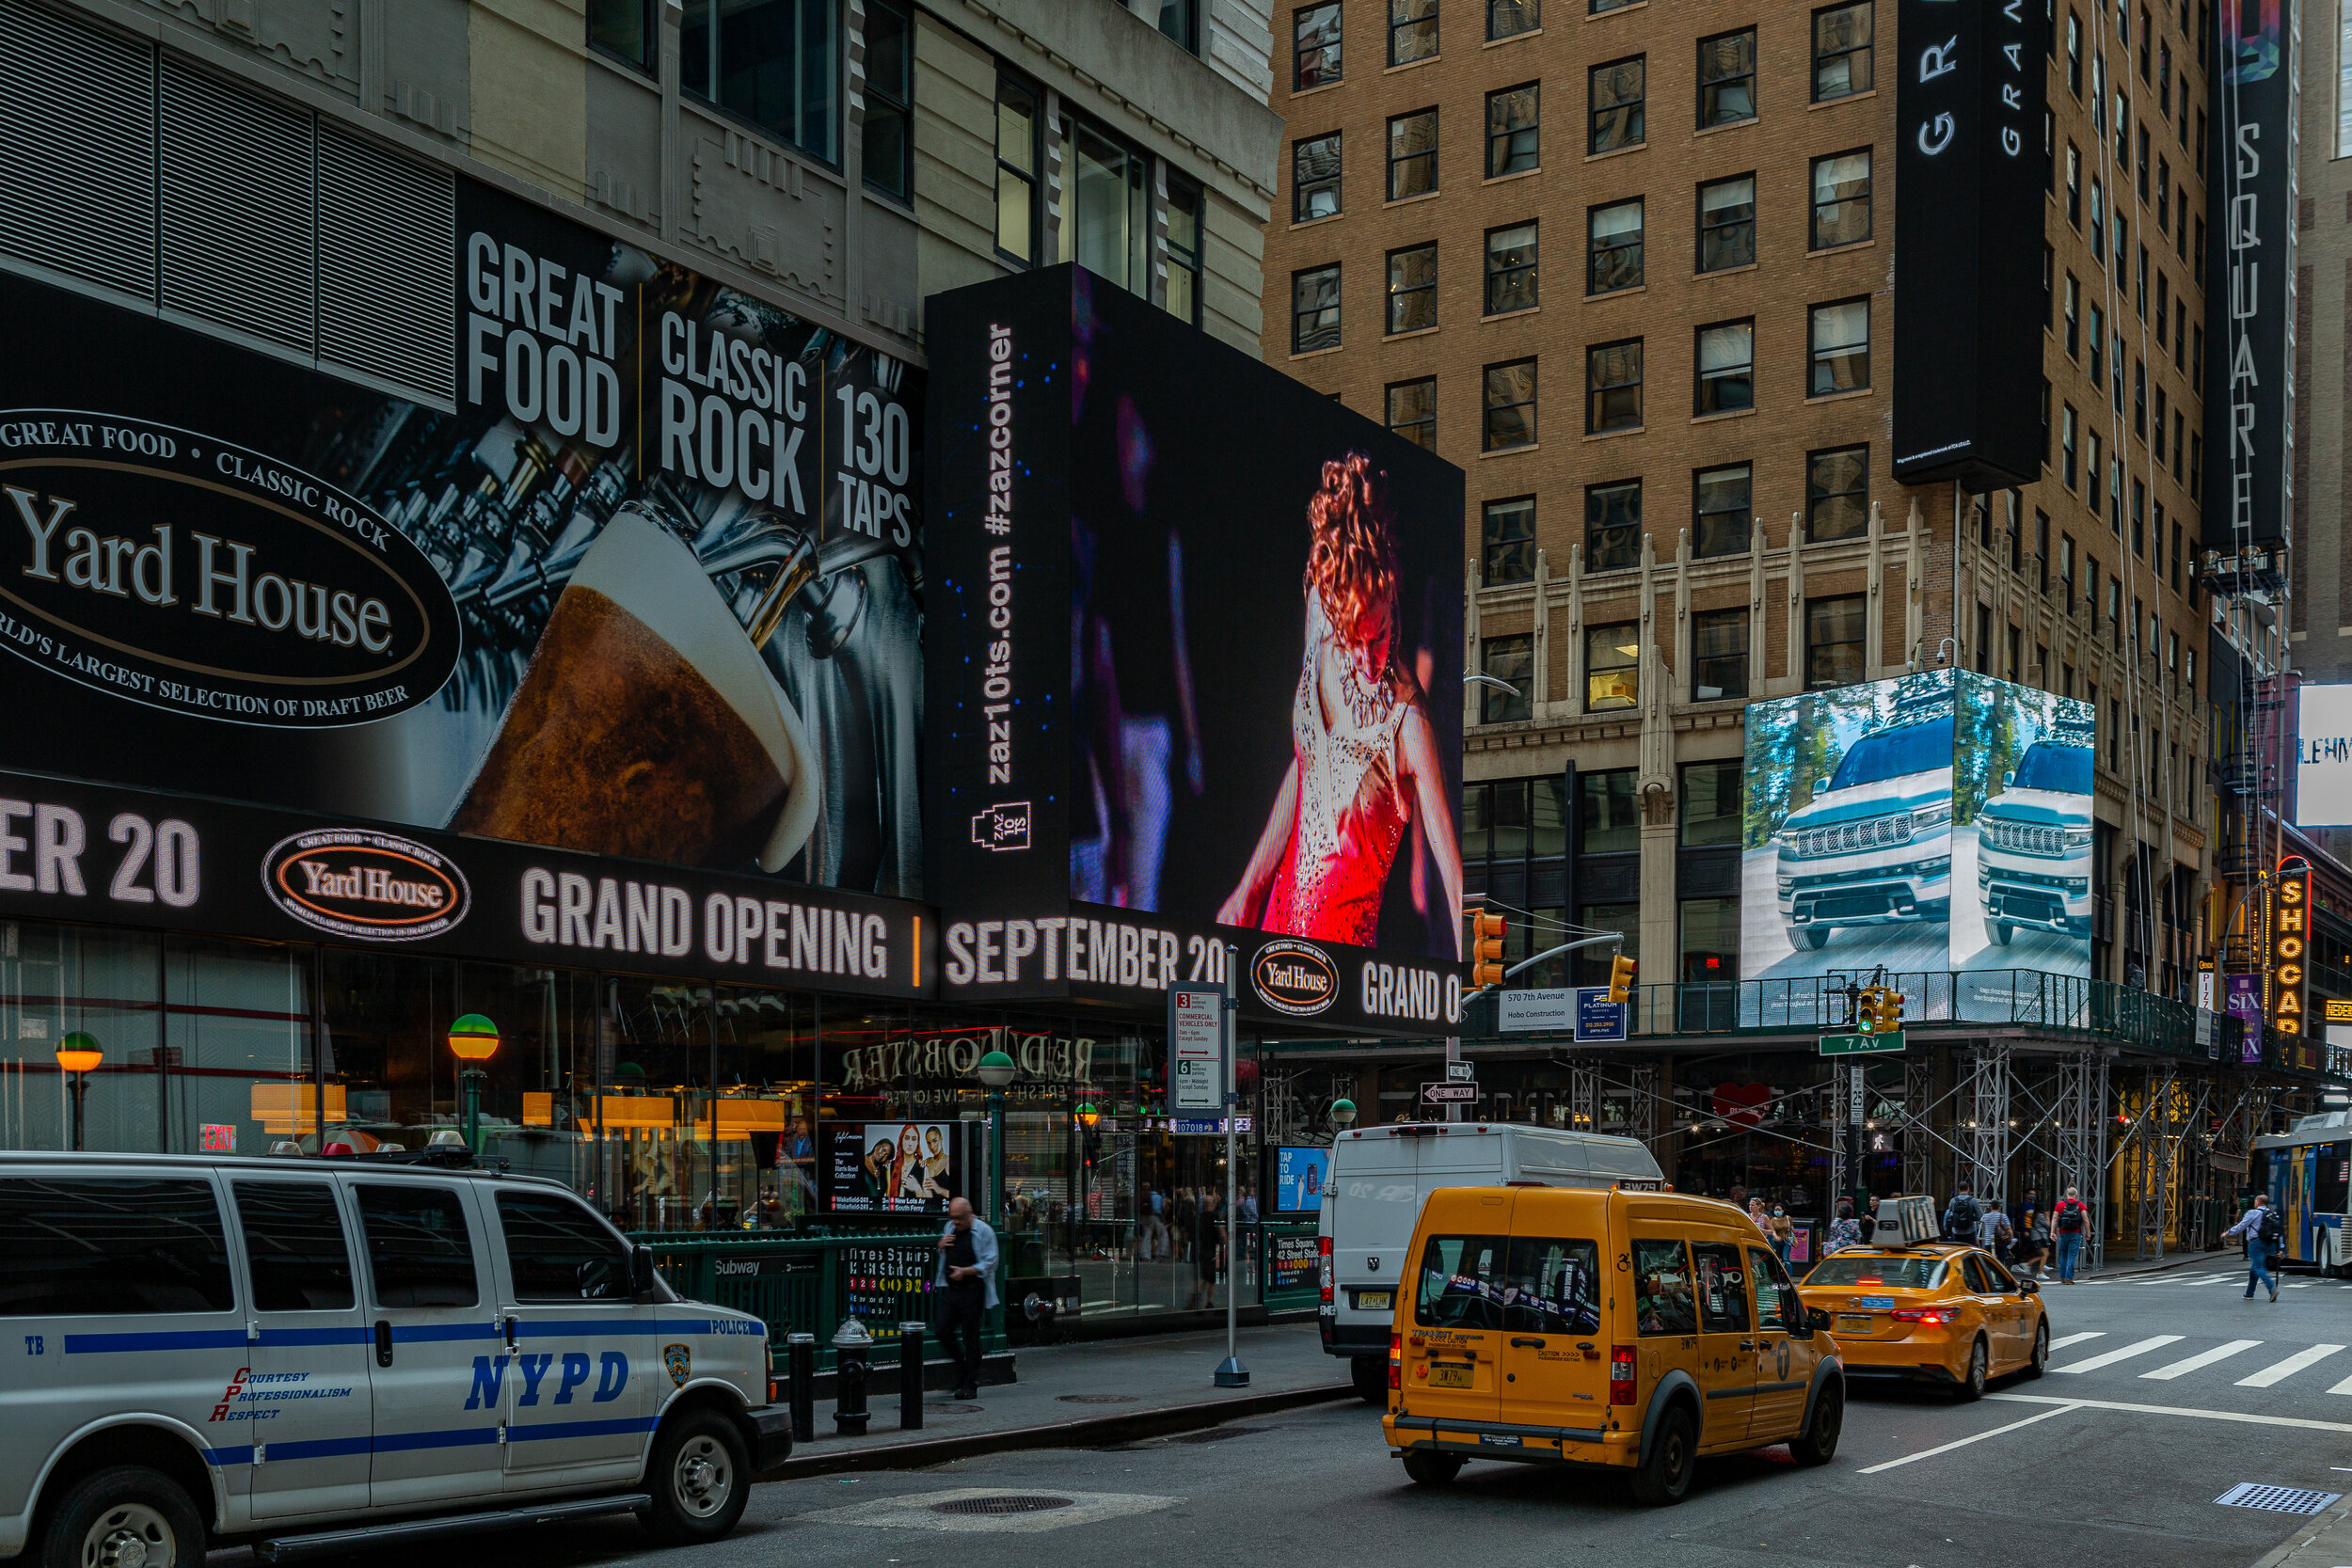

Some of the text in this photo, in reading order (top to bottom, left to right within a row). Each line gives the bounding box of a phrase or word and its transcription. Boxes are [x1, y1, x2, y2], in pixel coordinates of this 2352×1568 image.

[1917, 0, 1958, 155] GR
[469, 231, 622, 361] GREAT
[2230, 122, 2261, 529] SQUARE
[661, 310, 806, 422] CLASSIC
[469, 311, 620, 448] FOOD
[661, 376, 805, 515] ROCK
[836, 384, 909, 486] 130
[0, 422, 390, 552] GREAT FOOD CLASSIC ROCK
[837, 472, 911, 547] TAPS
[984, 324, 1011, 784] zaz10ts.com #zazcorner
[3, 483, 392, 653] Yard House
[56, 643, 154, 693] LARGEST
[159, 678, 269, 715] SELECTION
[274, 699, 298, 716] OF
[303, 697, 361, 716] DRAFT
[365, 685, 410, 710] BEER
[993, 814, 1004, 841] ZAZ
[1014, 816, 1026, 835] TS
[109, 815, 200, 909] 20
[298, 860, 444, 909] Yard House
[520, 867, 887, 979] GRAND OPENING
[945, 916, 1178, 990] SEPTEMBER
[1265, 961, 1327, 992] Yard House
[1180, 994, 1188, 1007] 3
[1363, 960, 1439, 1021] GRAND
[1446, 974, 1462, 1023] O
[1508, 993, 1521, 1002] 570
[1845, 1038, 1853, 1050] 7
[1180, 1061, 1188, 1074] 6
[1430, 1089, 1470, 1098] ONE WAY
[1853, 1091, 1862, 1106] 25
[205, 1125, 233, 1150] EXIT
[1177, 1123, 1203, 1132] 107018
[1279, 1151, 1293, 1163] TAP
[1279, 1164, 1289, 1174] TO
[1279, 1174, 1295, 1185] RIDE
[1277, 1239, 1295, 1249] Times
[1277, 1250, 1286, 1259] 42
[1286, 1249, 1303, 1259] Street
[715, 1259, 760, 1276] Subway
[711, 1320, 750, 1336] POLICE
[1412, 1329, 1453, 1338] TRANSIT
[24, 1335, 44, 1354] TB
[232, 1367, 310, 1385] COURTESY
[463, 1351, 628, 1410] NYPD
[221, 1386, 352, 1402] PROFESSIONALISM
[208, 1404, 280, 1422] RESPECT
